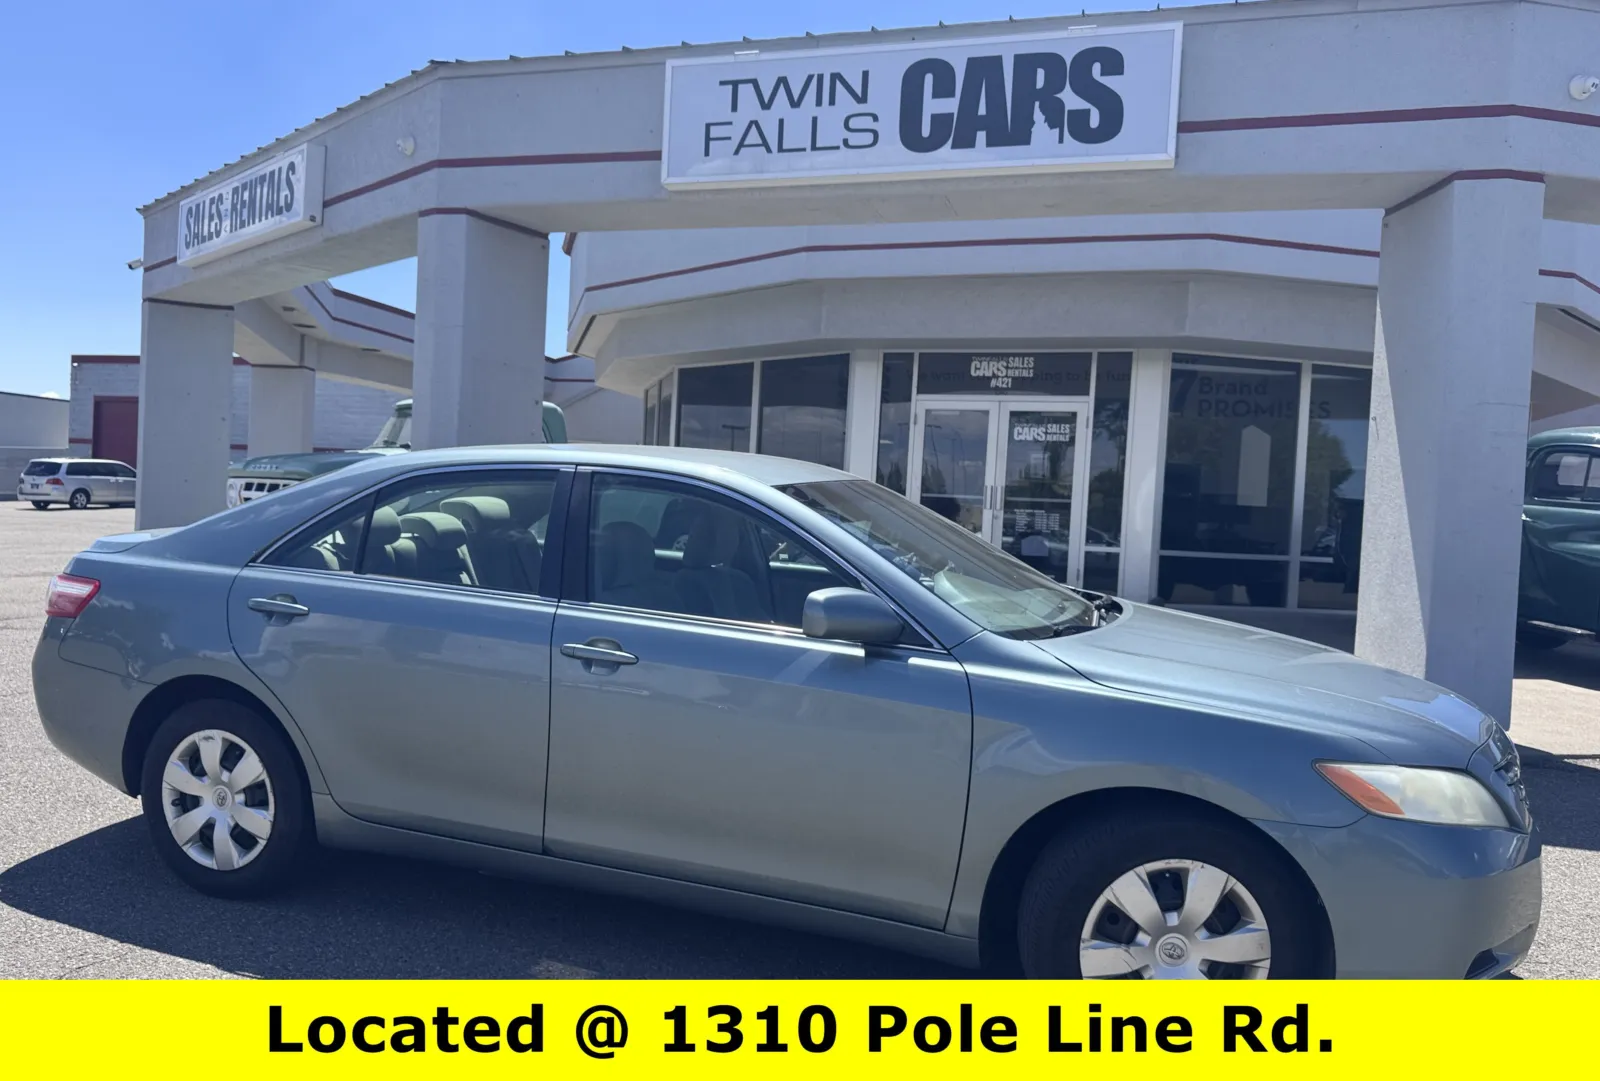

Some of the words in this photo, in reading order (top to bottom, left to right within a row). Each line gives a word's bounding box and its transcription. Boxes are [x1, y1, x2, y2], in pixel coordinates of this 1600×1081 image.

[719, 70, 870, 113] TWIN
[899, 46, 1125, 153] CARS
[704, 112, 880, 157] FALLS
[184, 193, 224, 250] SALES
[229, 161, 296, 233] RENTALS
[970, 361, 1007, 377] CARS
[1008, 356, 1034, 368] SALES
[1007, 368, 1034, 378] RENTALS
[990, 377, 1012, 389] #421
[1198, 376, 1269, 396] Brand
[1014, 426, 1046, 442] CARS
[1047, 424, 1070, 434] SALES
